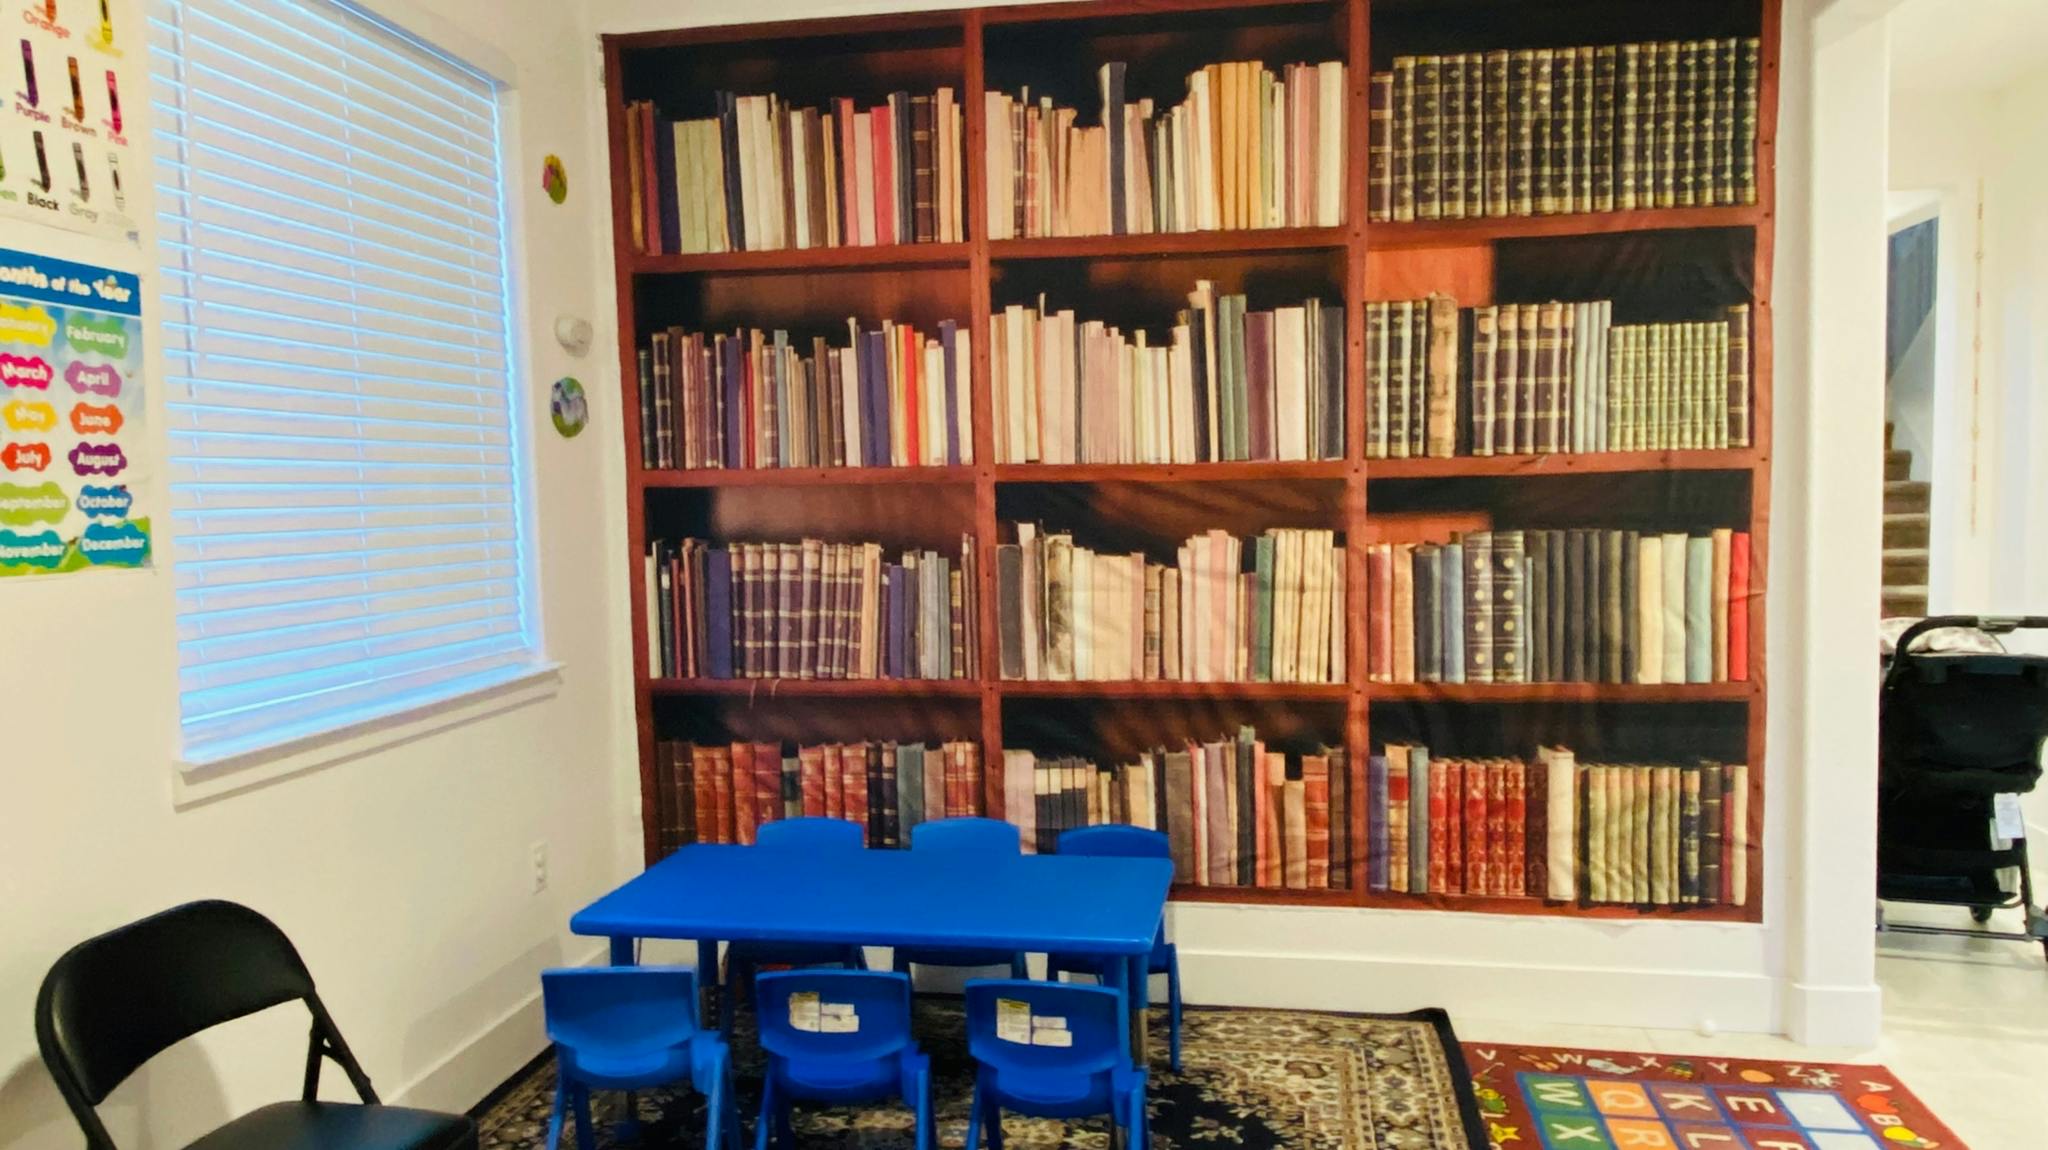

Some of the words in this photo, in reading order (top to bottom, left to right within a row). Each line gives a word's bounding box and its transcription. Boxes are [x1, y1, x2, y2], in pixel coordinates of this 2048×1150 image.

[23, 10, 70, 39] Orange
[15, 102, 50, 123] Purple
[61, 117, 97, 137] Brown
[27, 192, 60, 211] Black
[69, 202, 98, 224] Gray
[51, 276, 66, 292] of
[68, 278, 91, 296] the
[66, 325, 125, 348] February
[1, 361, 47, 381] March
[77, 371, 110, 386] April
[79, 412, 112, 427] June
[15, 450, 42, 468] July
[77, 452, 121, 469] August
[79, 495, 129, 510] October
[81, 536, 145, 552] December
[1552, 1053, 1584, 1065] W
[1638, 1055, 1663, 1068] X
[1707, 1061, 1729, 1074] Y
[1783, 1065, 1811, 1077] Z
[1533, 1082, 1584, 1106] W
[1860, 1080, 1893, 1092] A
[1600, 1089, 1646, 1109] Q
[1661, 1092, 1713, 1112] K
[1725, 1096, 1776, 1114] E
[1869, 1113, 1904, 1126] B
[1551, 1123, 1602, 1142] X
[1616, 1126, 1667, 1147] R
[1685, 1132, 1732, 1150] L
